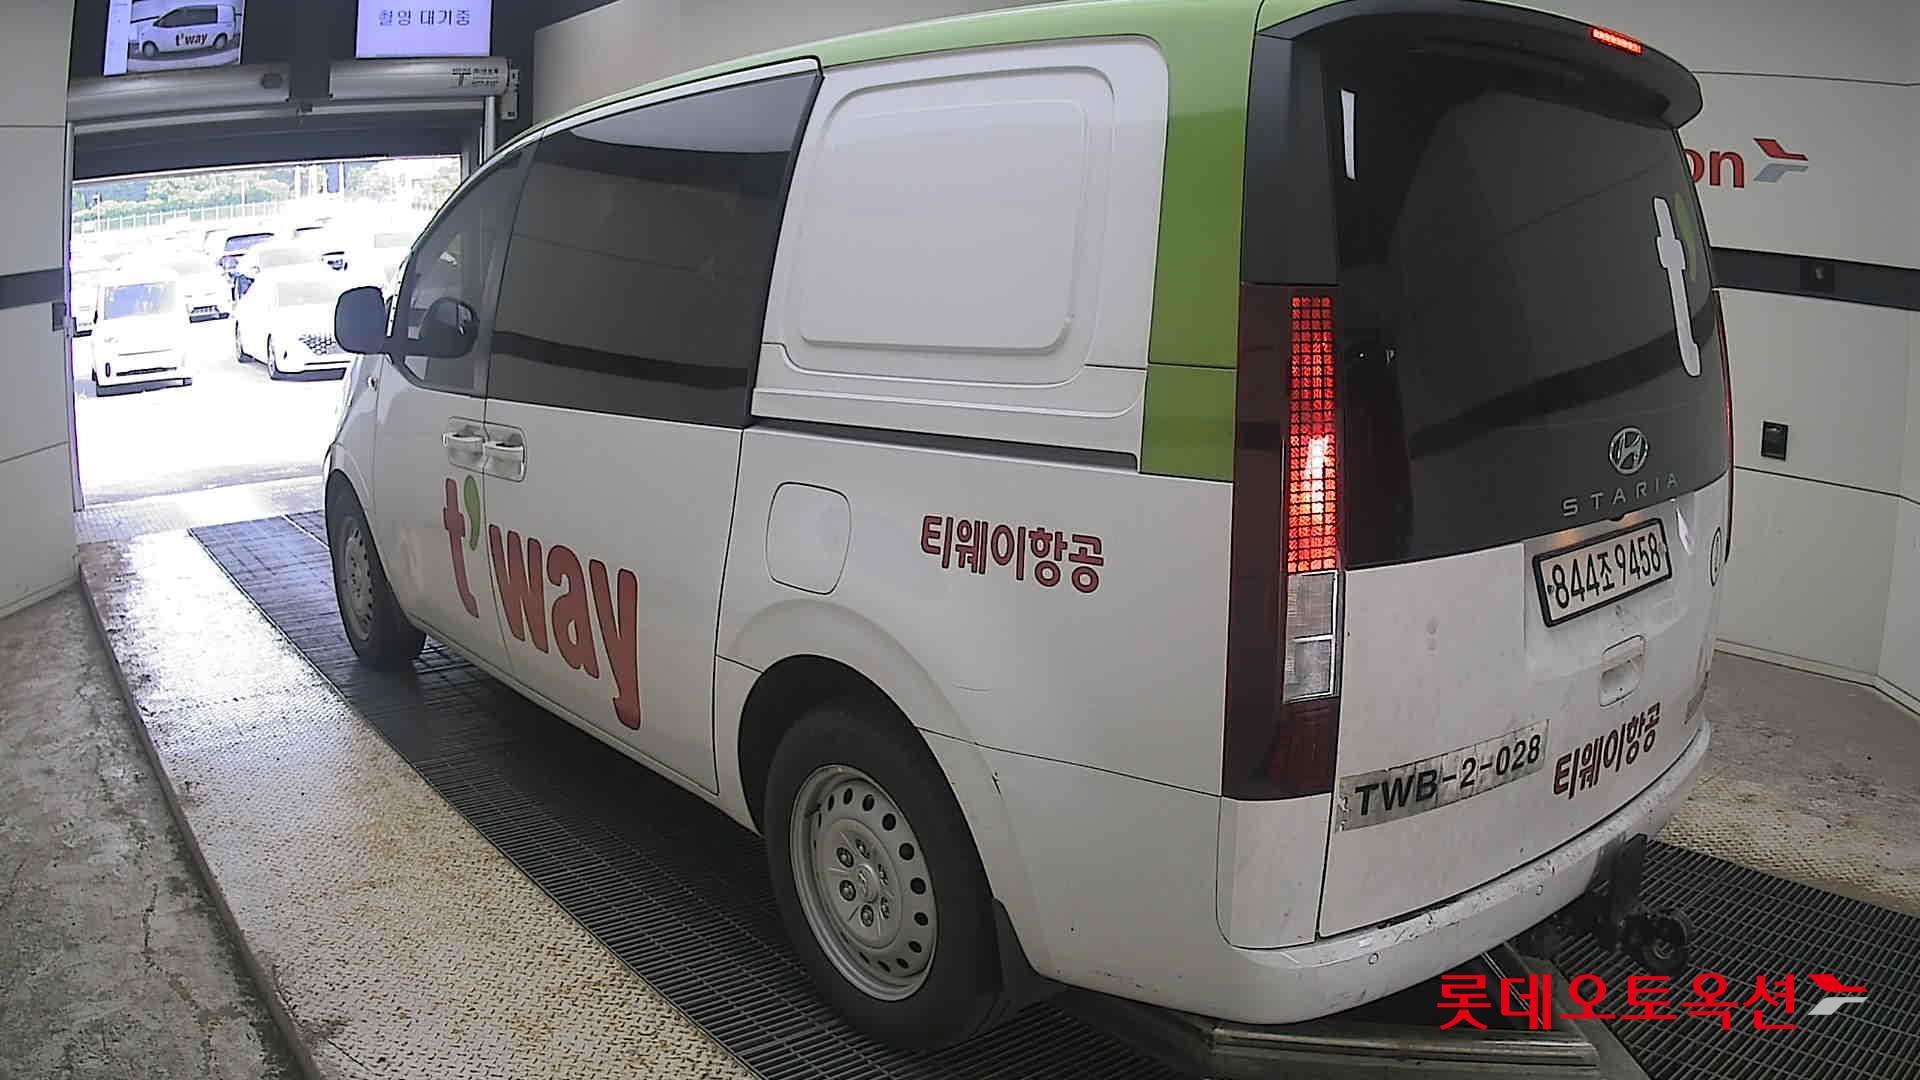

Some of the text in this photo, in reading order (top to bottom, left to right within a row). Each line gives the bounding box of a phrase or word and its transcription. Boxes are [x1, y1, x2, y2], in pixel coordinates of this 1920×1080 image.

[420, 9, 470, 26] 대기중
[1562, 474, 1679, 517] STARIA
[921, 515, 1104, 593] 티웨이항공
[1355, 735, 1541, 816] TWB-2-028
[1553, 702, 1661, 800] 티웨이항공
